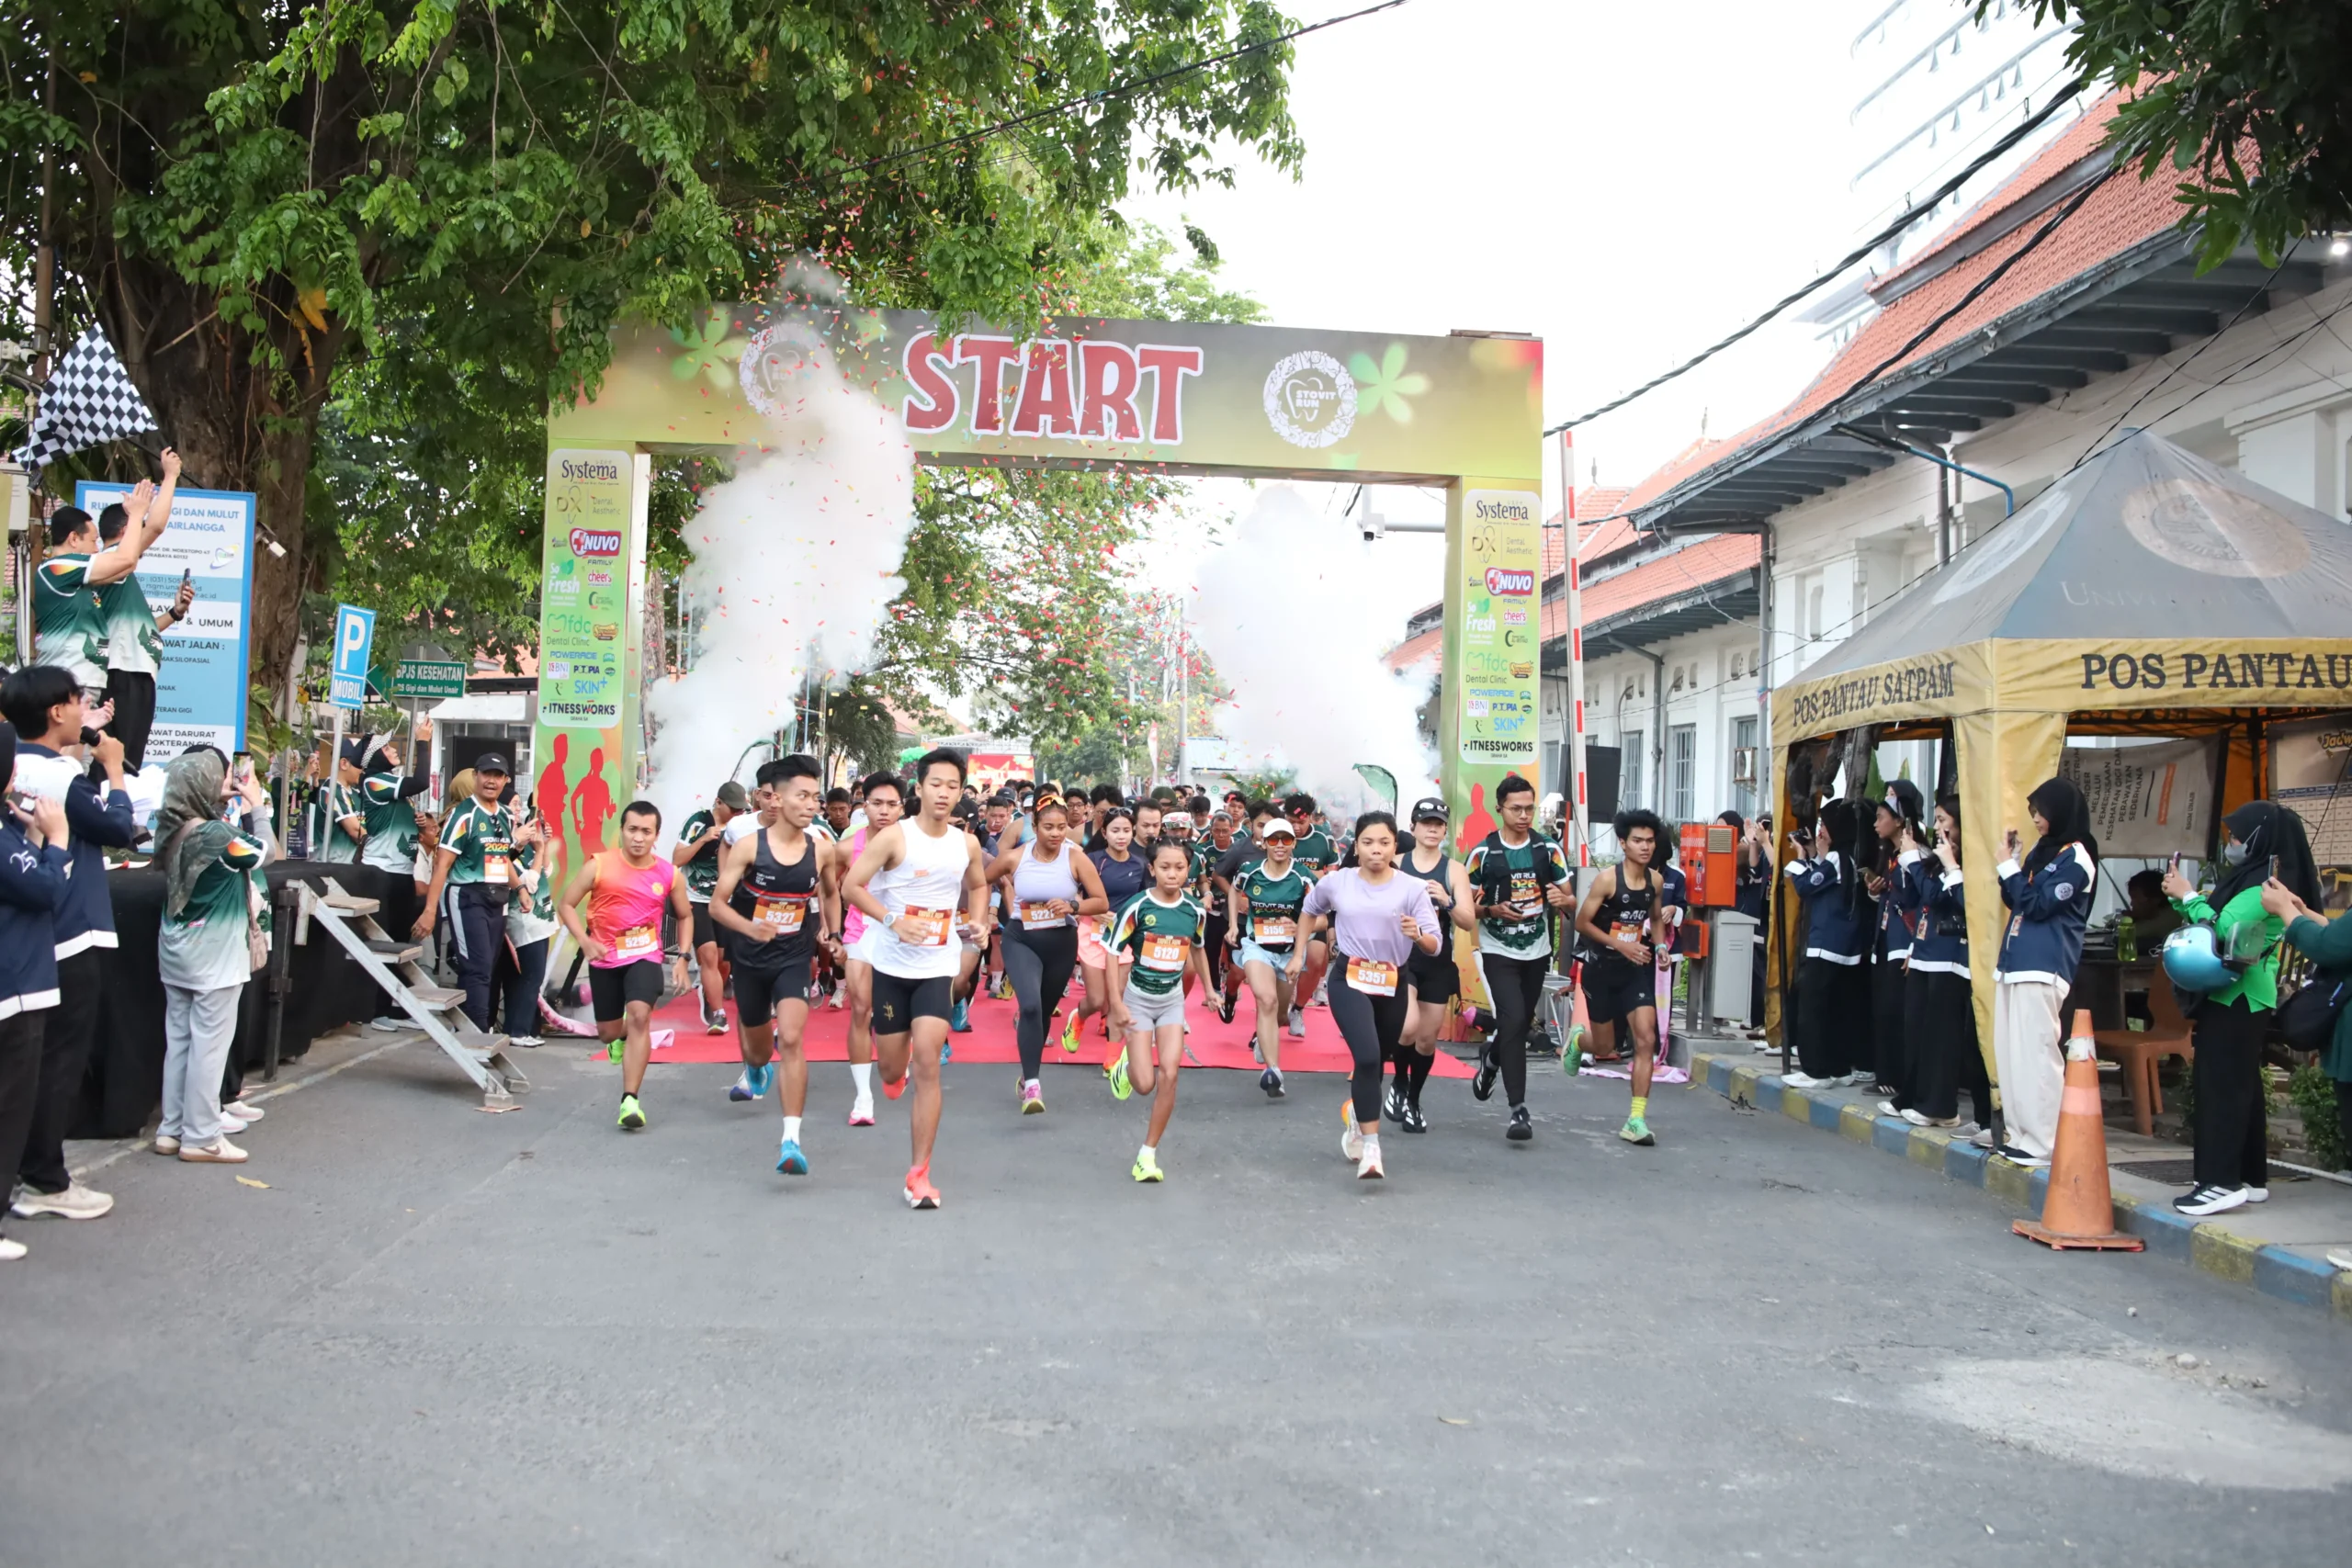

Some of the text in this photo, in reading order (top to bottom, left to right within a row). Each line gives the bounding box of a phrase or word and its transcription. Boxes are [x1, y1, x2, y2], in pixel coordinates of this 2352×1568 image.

[903, 331, 1204, 446] START
[1296, 389, 1336, 400] STOVIT
[1295, 399, 1319, 408] RUN
[561, 459, 617, 482] Systema
[184, 509, 204, 518] DAN
[207, 510, 240, 519] MULUT
[1476, 500, 1529, 522] Systema
[166, 521, 225, 533] AIRLANGGA
[583, 535, 619, 551] NUVO
[1506, 537, 1525, 546] Dental
[549, 562, 560, 574] So
[588, 570, 612, 582] cheers
[1499, 574, 1532, 591] NUVO
[548, 575, 581, 593] Fresh
[1467, 601, 1476, 613] So
[1504, 608, 1526, 621] cheers
[187, 617, 233, 627] & UMUM
[568, 615, 592, 633] fdc
[1466, 614, 1496, 632] Fresh
[188, 640, 220, 649] JALAN
[341, 614, 366, 671] P
[546, 637, 590, 647] Dental Clinic
[550, 650, 597, 660] POWERADE
[555, 661, 569, 672] BNI
[1486, 653, 1508, 671] fdc
[396, 664, 462, 682] BPJS KESEHATAN
[2081, 652, 2352, 690] POS PANTAU
[1466, 674, 1507, 683] Dental Clinic
[334, 680, 361, 701] MOBIL
[405, 684, 416, 694] Gigi
[417, 684, 427, 693] dan
[428, 685, 443, 694] Mulut
[444, 685, 458, 694] Unair
[1470, 689, 1514, 697] POWERADE
[1793, 661, 1954, 727] POS PANTAU SATPAM
[1475, 701, 1487, 710] BNI
[147, 739, 195, 747] DOKTERAN
[2091, 774, 2101, 813] MELALUI
[2098, 761, 2111, 825] PEMERIKSAAN
[2119, 765, 2132, 822] PERAWATAN
[2129, 766, 2143, 821] SEDERHANA
[2106, 789, 2120, 840] KESEHATAN
[484, 842, 509, 852] 2026
[1511, 879, 1537, 888] 026
[765, 910, 796, 924] 5327
[1263, 925, 1284, 935] 5150
[1358, 969, 1386, 985] 5351
